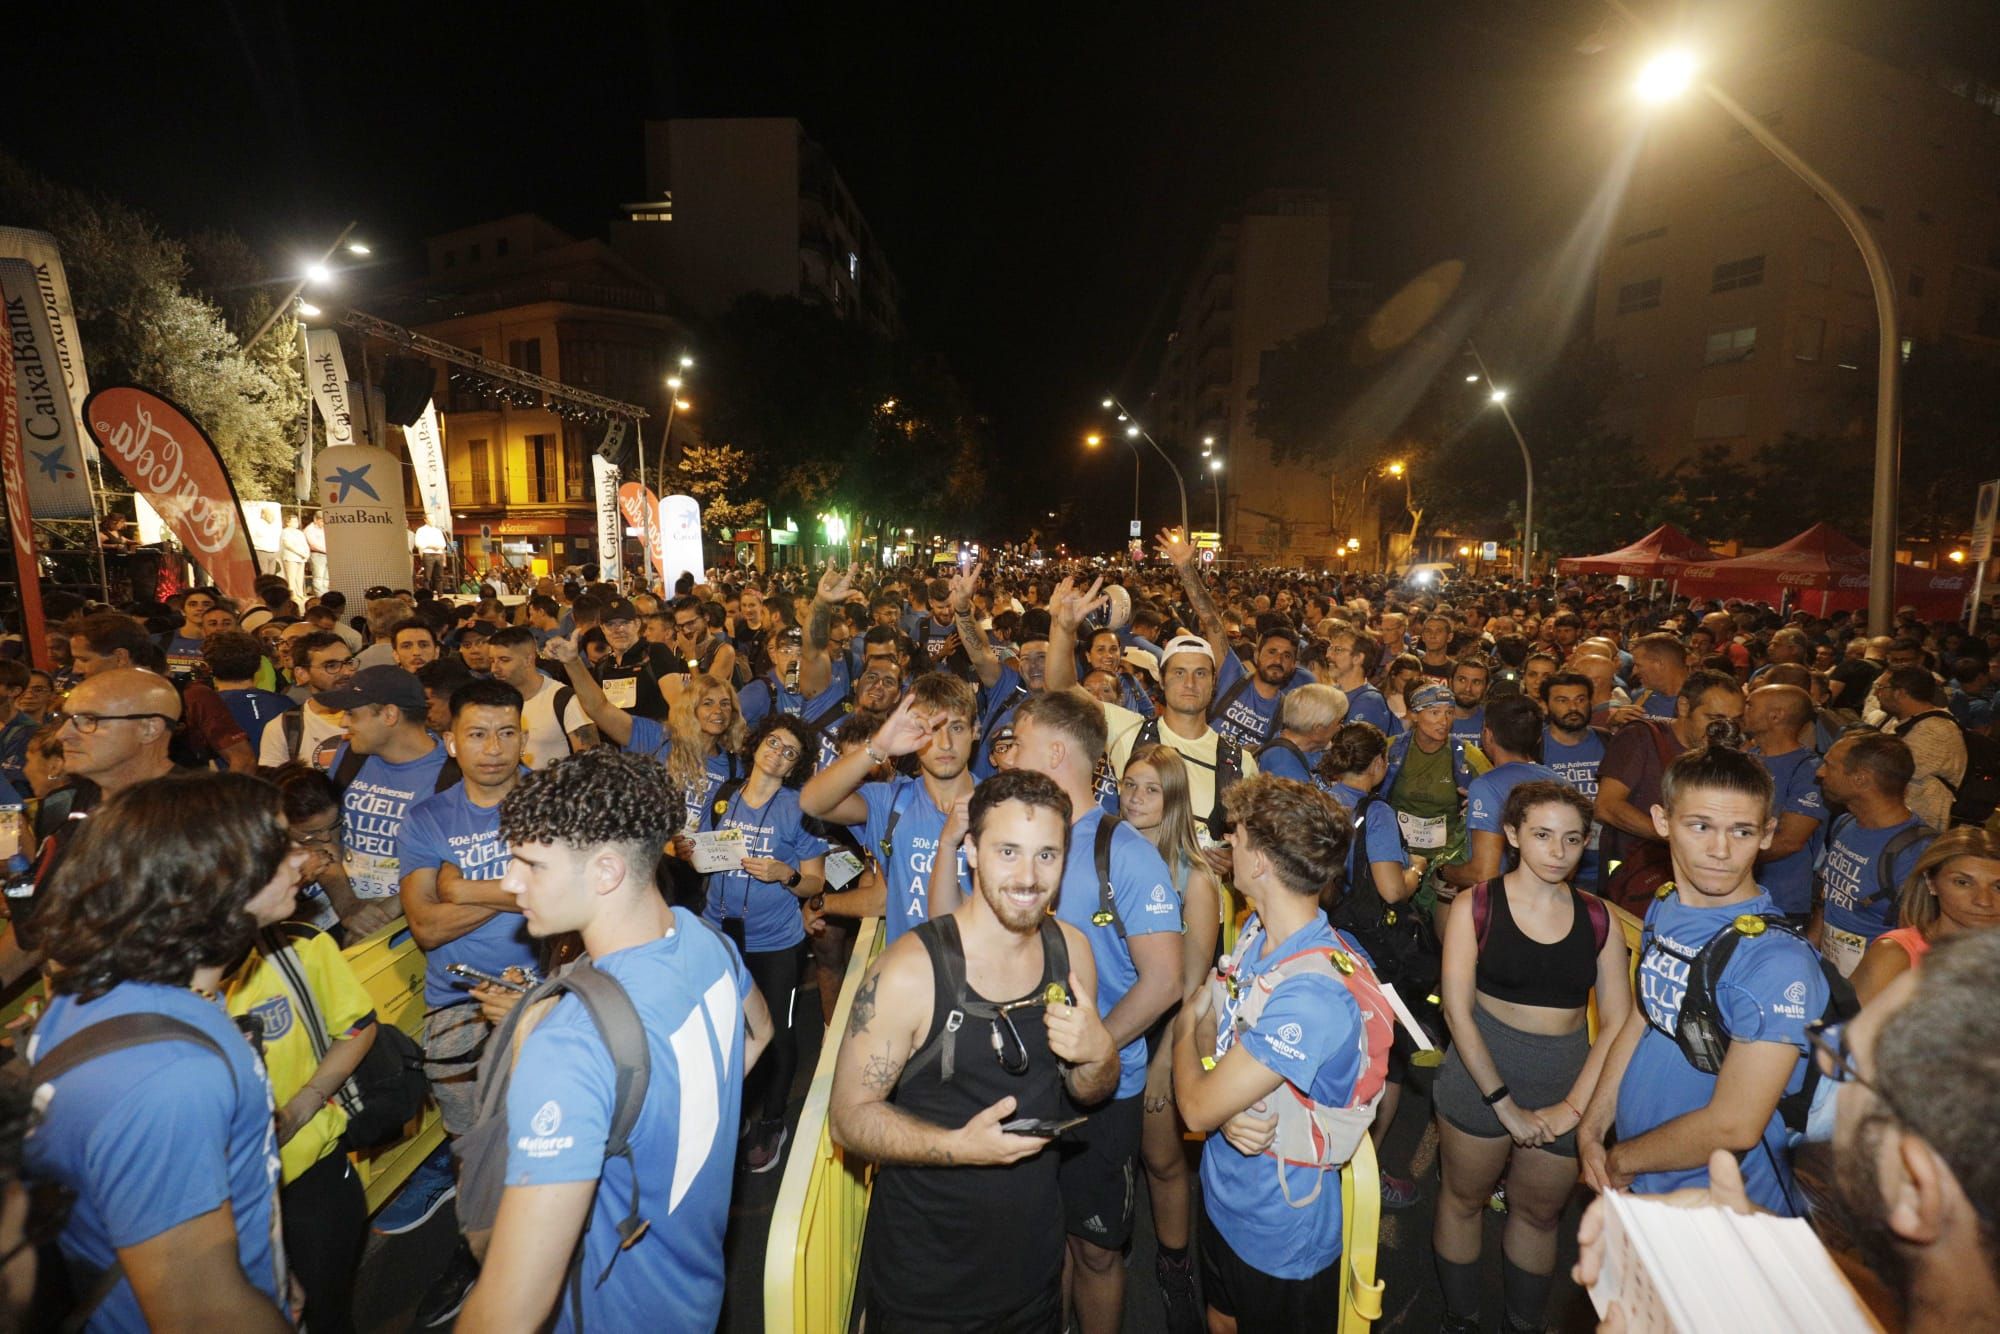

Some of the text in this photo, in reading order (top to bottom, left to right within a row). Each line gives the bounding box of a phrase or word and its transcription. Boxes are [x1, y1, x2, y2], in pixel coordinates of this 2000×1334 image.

[315, 352, 351, 442] CaixaBank
[323, 509, 393, 525] CaixaBank
[603, 468, 623, 560] CaixaBank
[1683, 566, 1716, 578] Coca-Cola
[1776, 571, 1817, 586] Coca-Cola
[1929, 576, 1963, 590] Coca-Cola
[1226, 707, 1265, 734] GÜELL
[367, 783, 415, 800] Aniversari
[344, 792, 408, 820] GÜELL
[342, 812, 353, 830] A
[738, 821, 775, 834] Aniversari
[354, 832, 395, 856] PEU
[448, 836, 471, 847] 50è
[743, 834, 774, 853] ELL
[912, 837, 930, 849] 50è
[1828, 850, 1861, 883] GÜELL
[909, 875, 926, 896] A
[1832, 871, 1860, 902] LLUC
[906, 897, 924, 918] A
[1145, 902, 1174, 912] Mallorca
[1829, 888, 1853, 911] PEU
[1264, 1033, 1306, 1061] Mallorca
[516, 1135, 574, 1152] Mallorca
